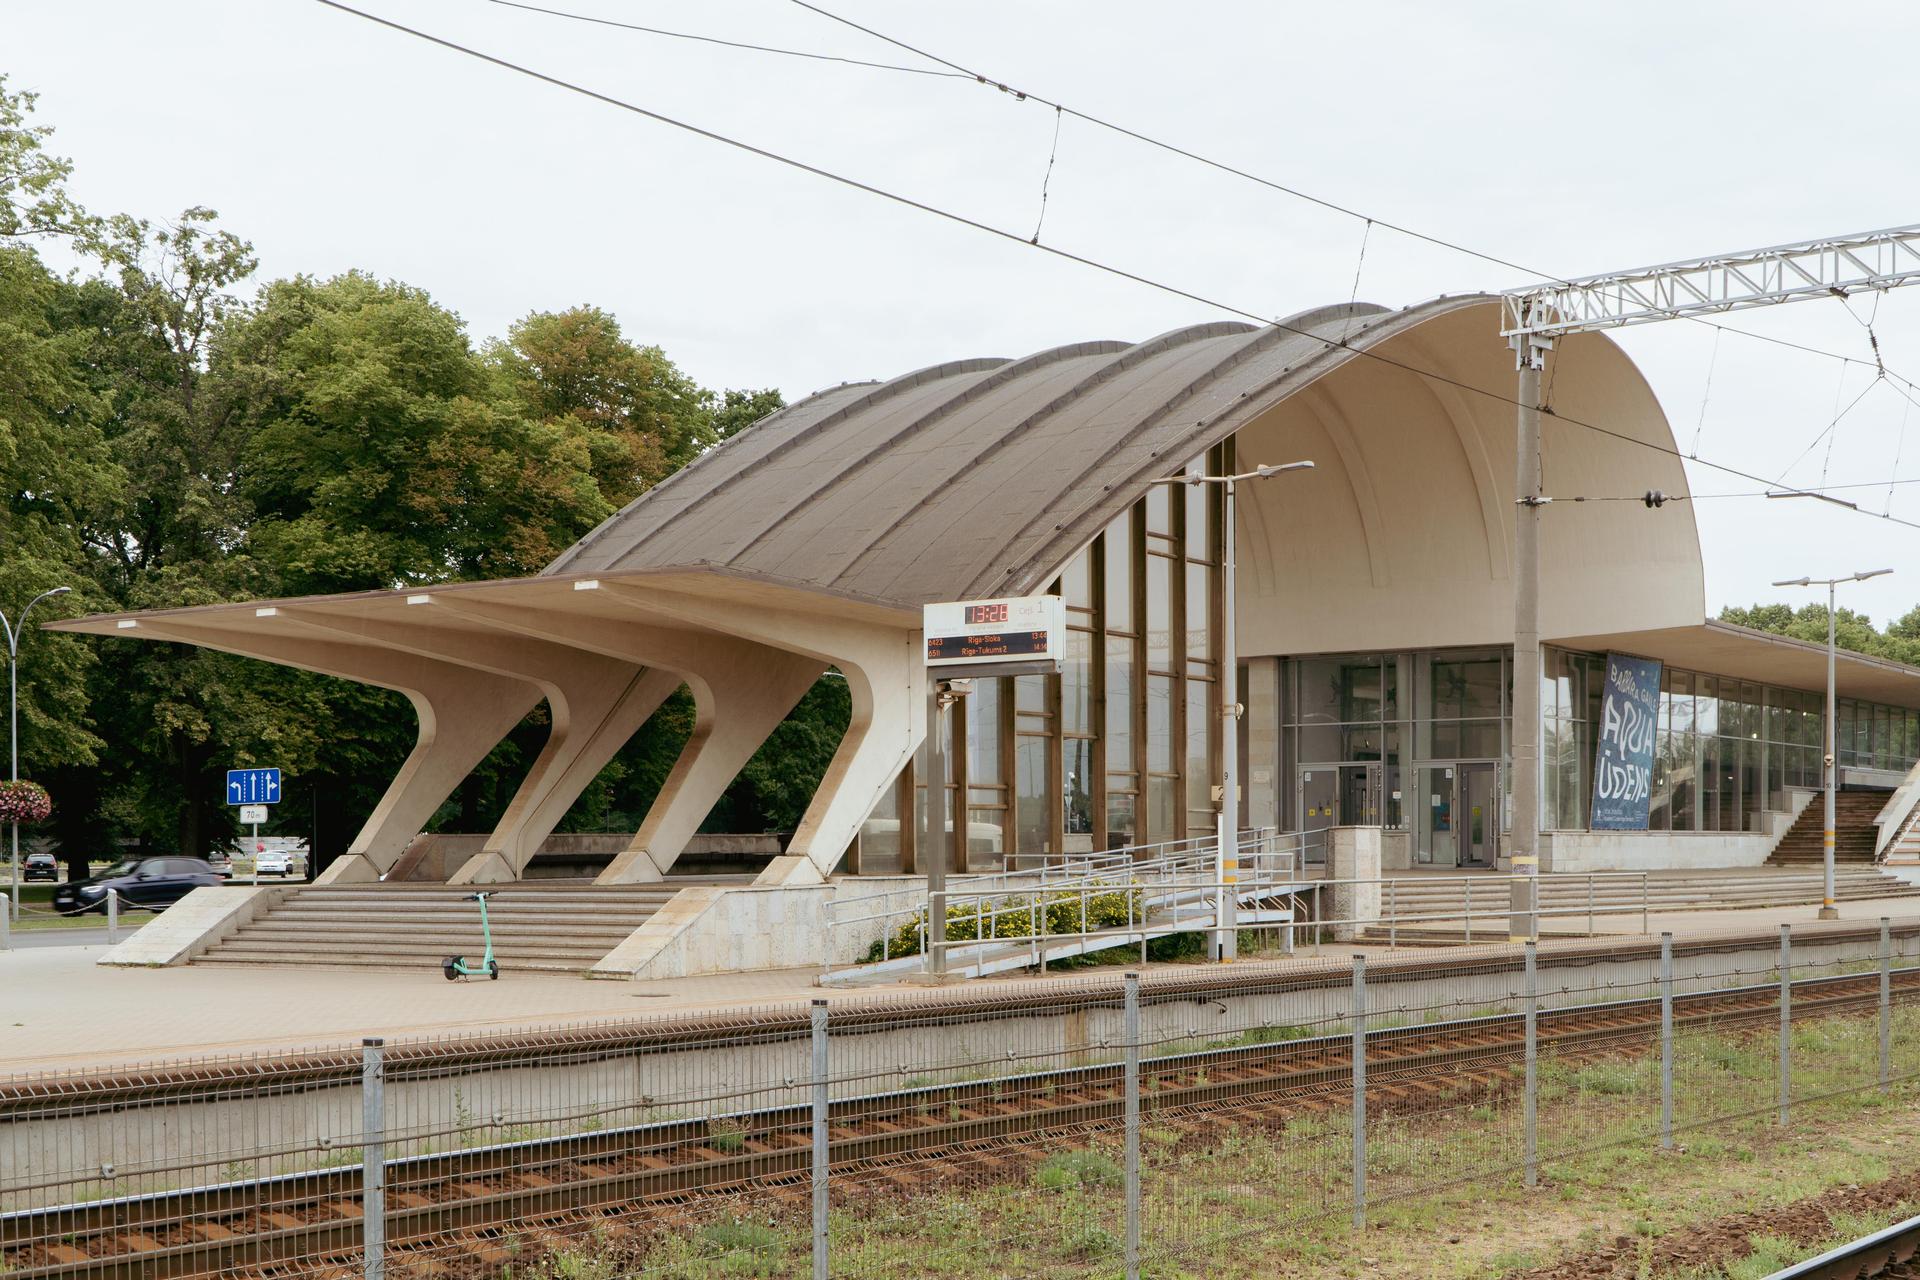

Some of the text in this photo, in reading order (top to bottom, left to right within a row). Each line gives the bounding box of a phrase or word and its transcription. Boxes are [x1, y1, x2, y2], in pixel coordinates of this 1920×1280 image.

[1603, 694, 1653, 761] AQUA
[1224, 771, 1229, 781] 9
[246, 810, 255, 819] 70
